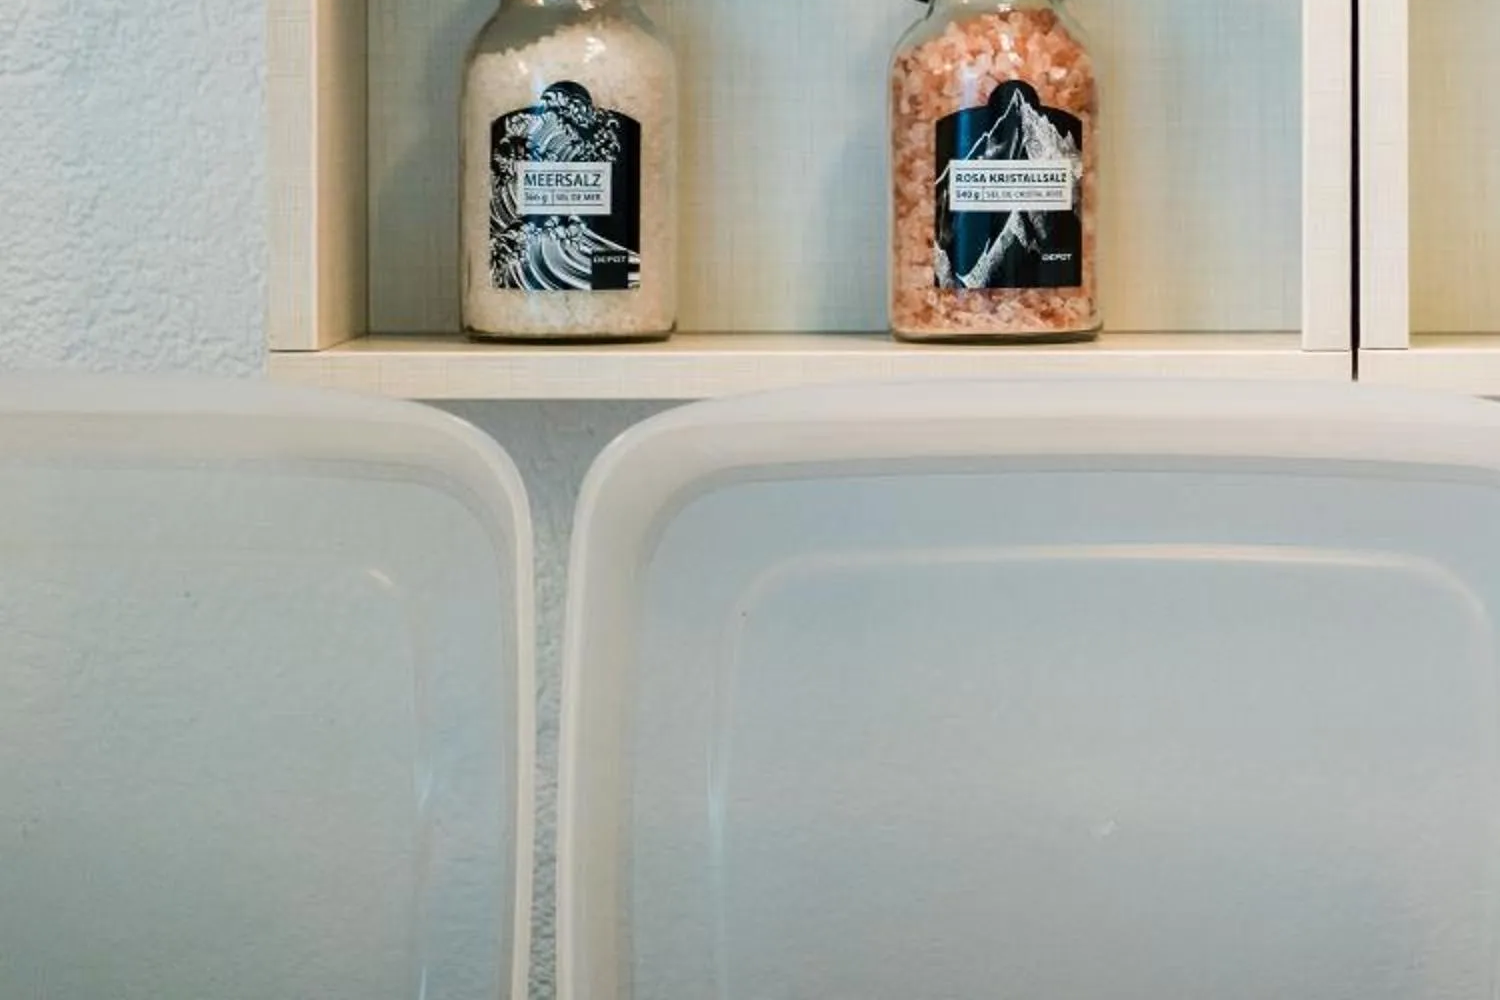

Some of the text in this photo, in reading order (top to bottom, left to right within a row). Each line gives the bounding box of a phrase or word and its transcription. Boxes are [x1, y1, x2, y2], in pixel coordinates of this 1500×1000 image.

[523, 173, 602, 188] MEERSALZ
[955, 173, 1067, 183] ROSA KRISTALLSALZ
[593, 255, 627, 263] DEPOT
